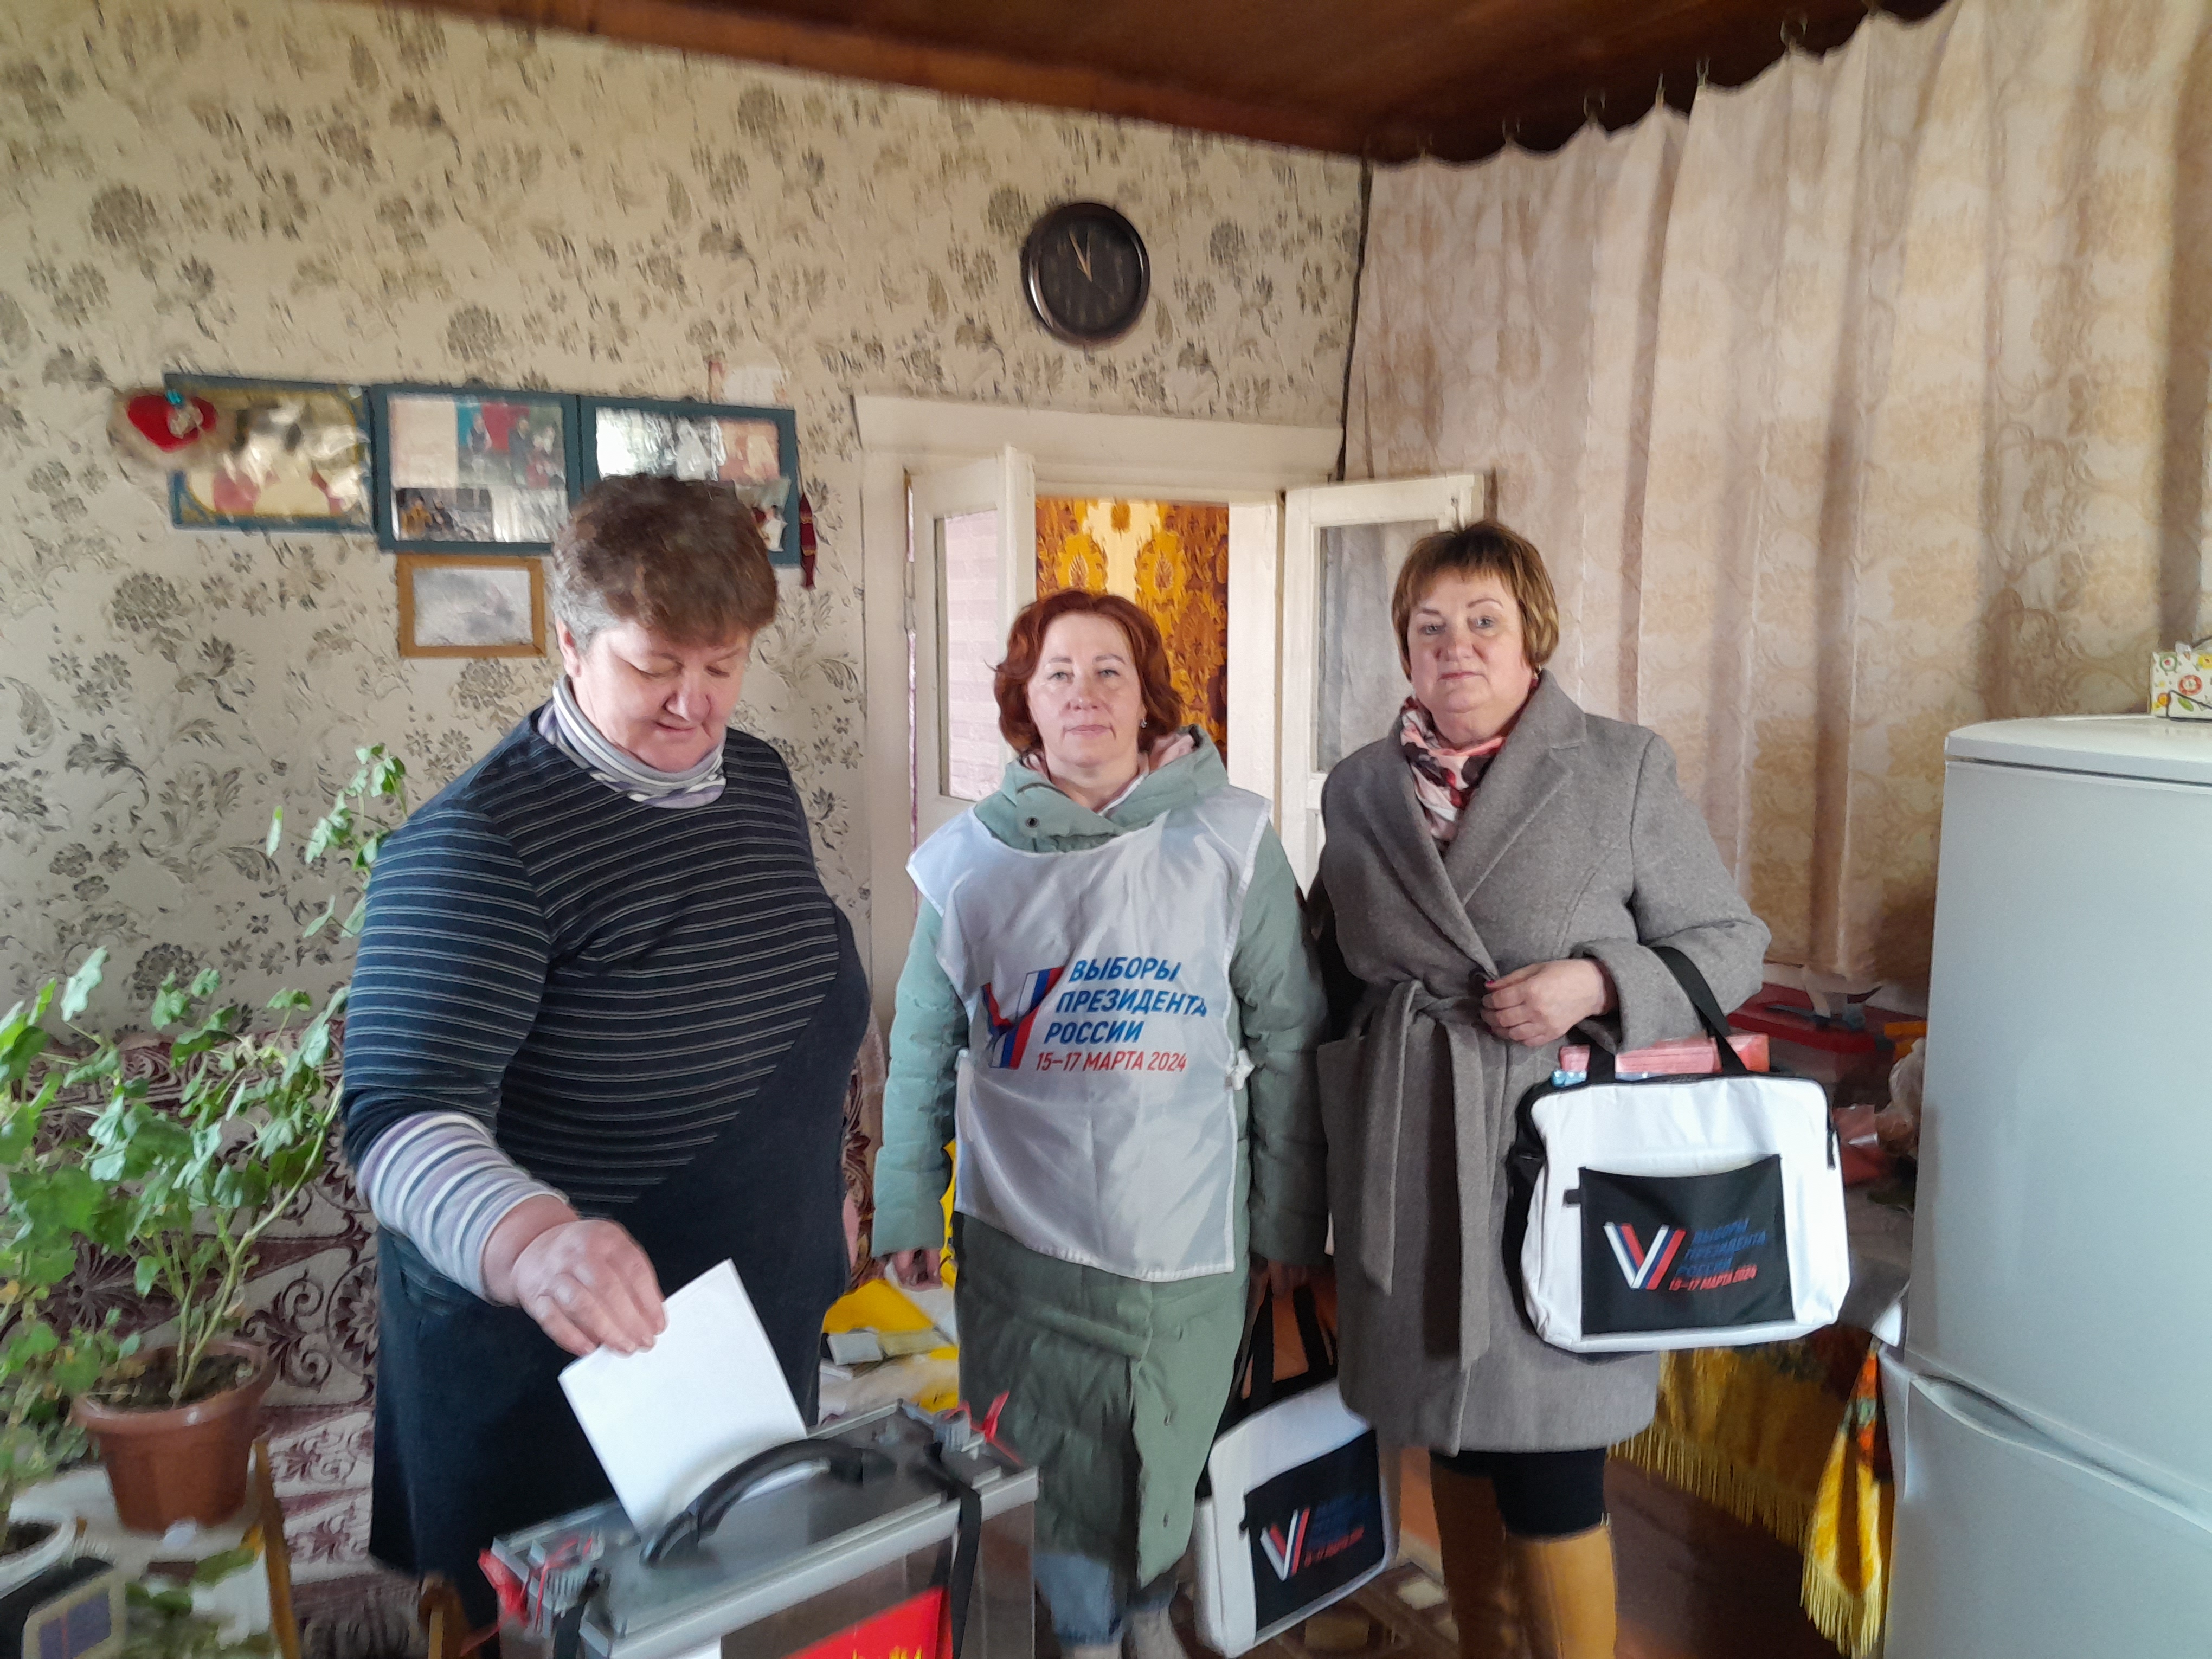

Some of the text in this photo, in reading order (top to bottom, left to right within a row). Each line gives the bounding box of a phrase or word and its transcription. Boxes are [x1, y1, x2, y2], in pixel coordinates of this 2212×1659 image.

[1068, 957, 1181, 982] ВЫБОРЫ
[1056, 988, 1207, 1017] ПРЕЗИДЕНТА
[1044, 1020, 1145, 1045] РОССИИ
[1082, 1051, 1144, 1071] МАРТА
[1147, 1051, 1187, 1072] 2024
